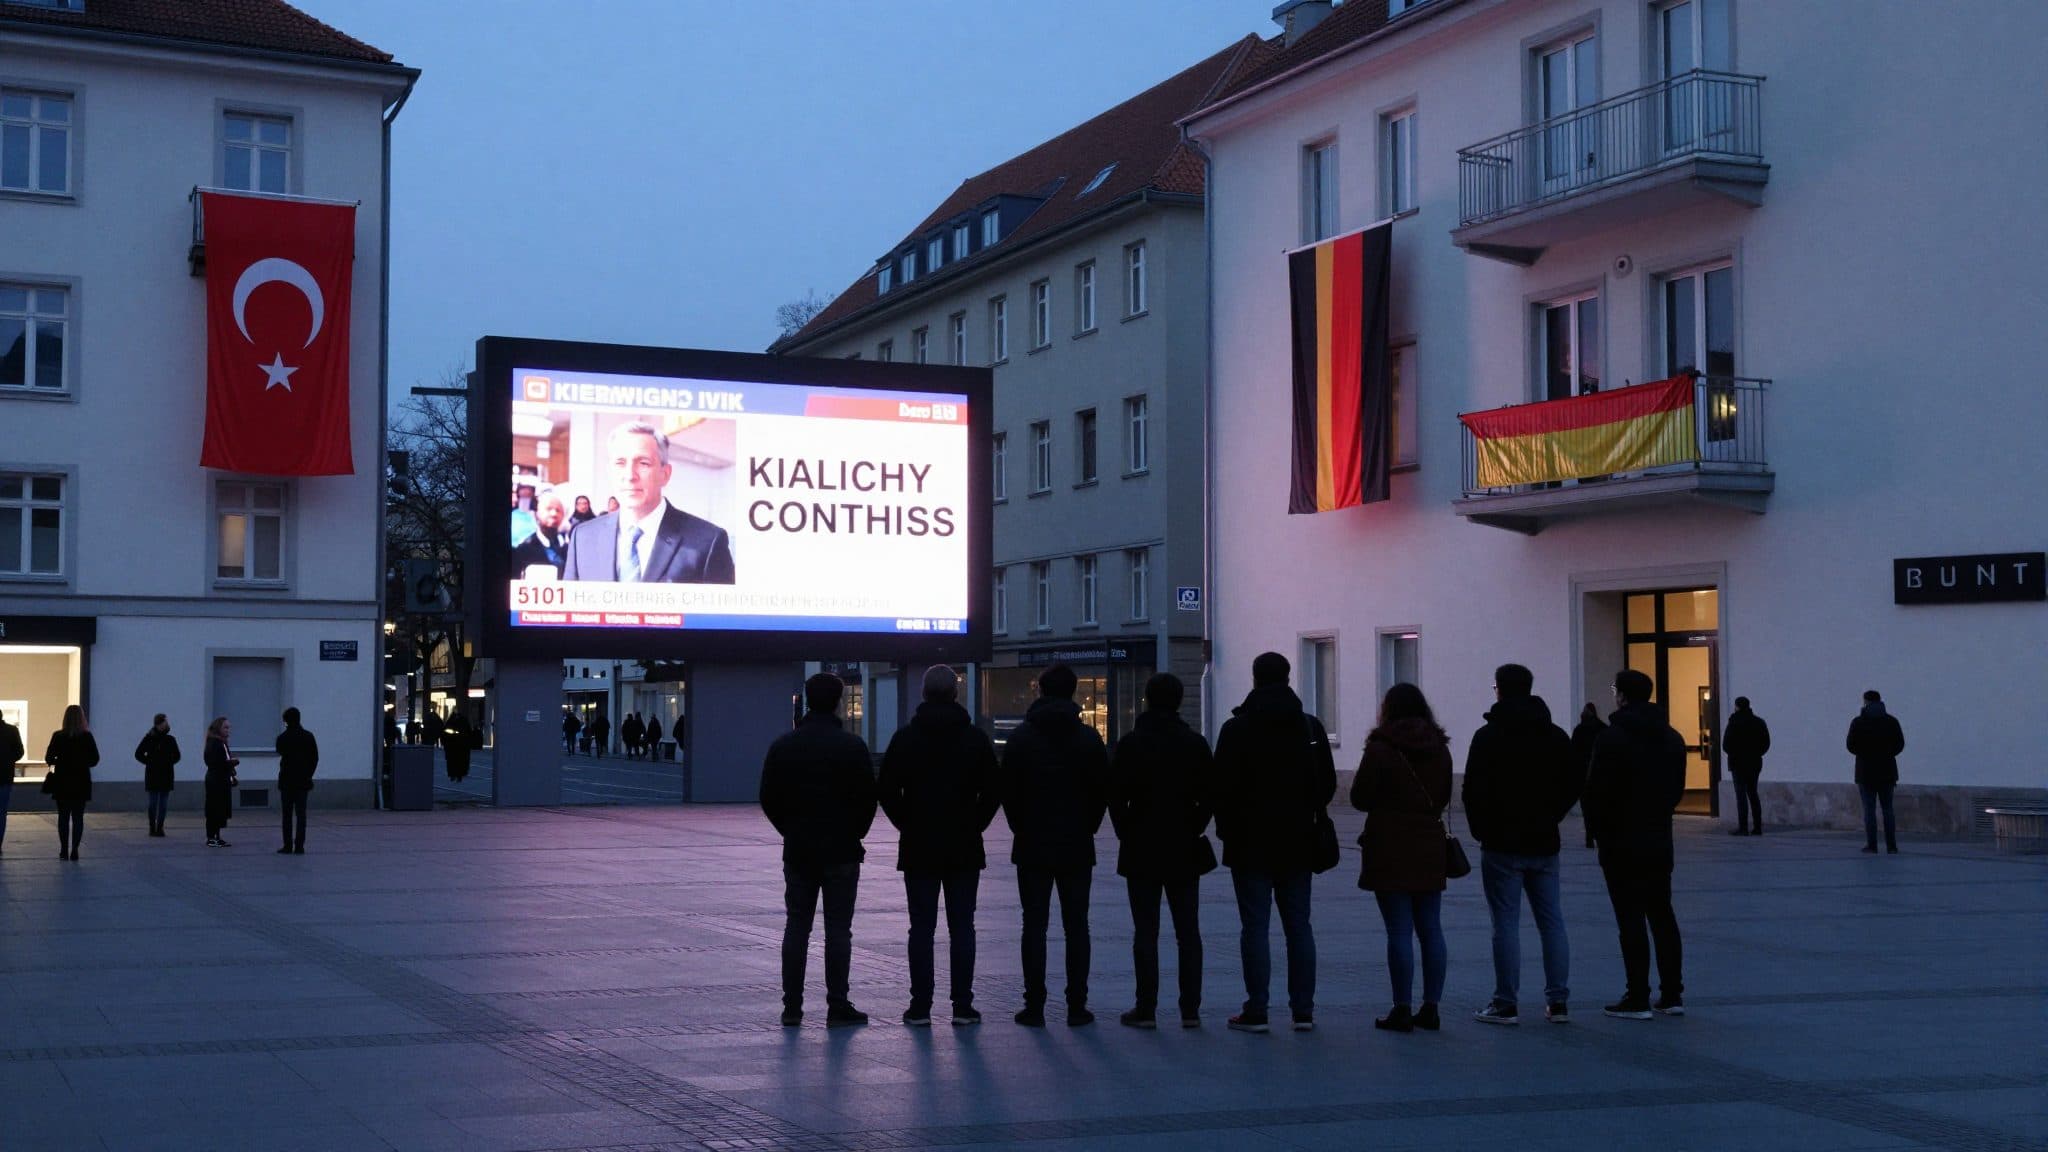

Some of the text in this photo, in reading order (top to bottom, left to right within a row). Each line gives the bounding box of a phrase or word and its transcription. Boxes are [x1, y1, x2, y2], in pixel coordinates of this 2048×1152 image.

[750, 457, 932, 493] KIALICHY
[749, 500, 955, 537] CONTHISS
[1906, 562, 2029, 588] BUNT
[518, 586, 565, 605] 5101
